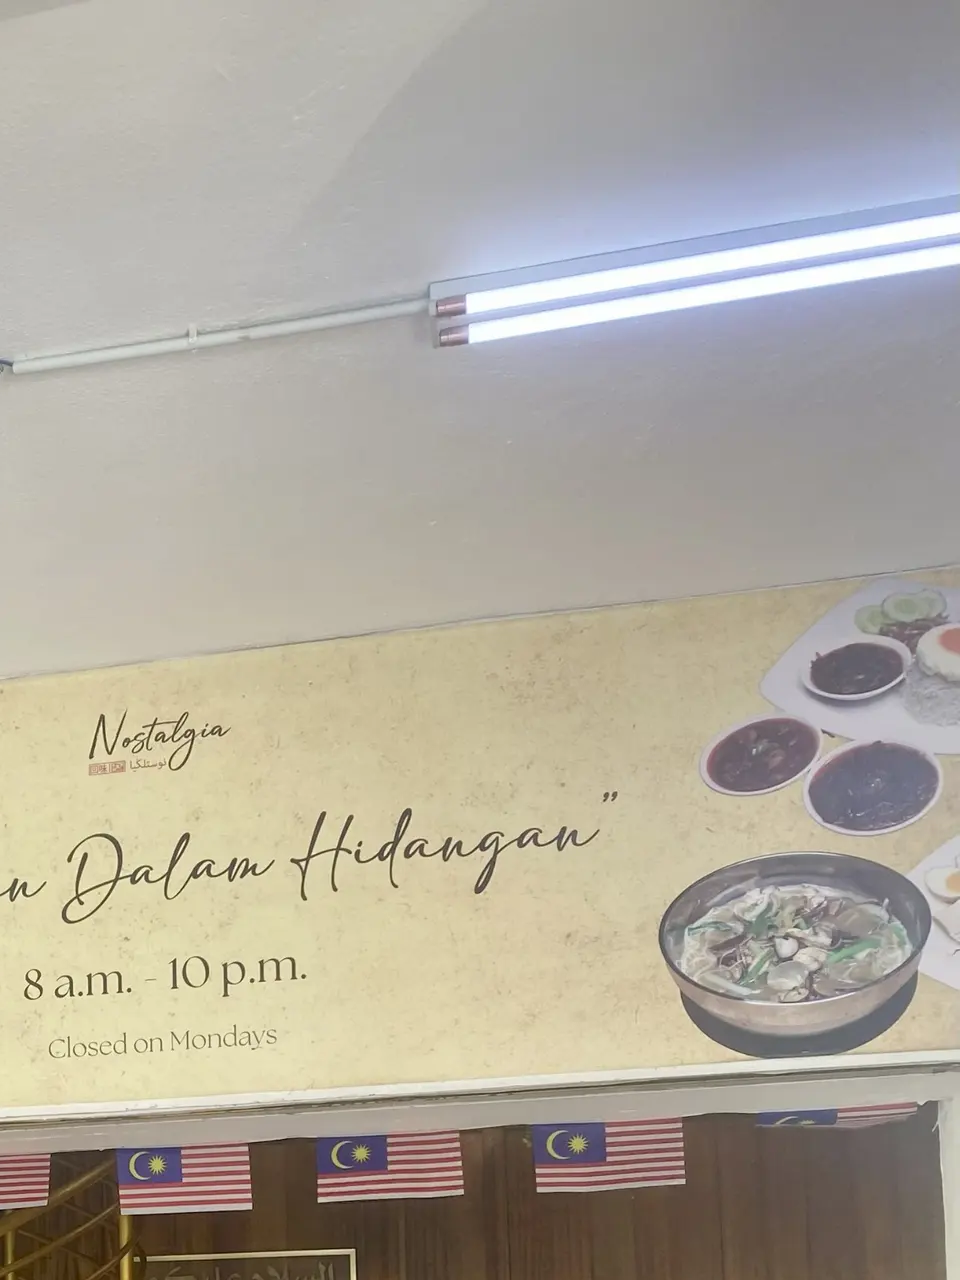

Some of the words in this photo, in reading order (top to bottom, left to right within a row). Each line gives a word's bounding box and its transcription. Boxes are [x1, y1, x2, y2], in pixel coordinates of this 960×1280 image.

[89, 708, 231, 771] Nostalgia
[62, 831, 275, 924] Dalam
[23, 968, 44, 1001] 8
[54, 970, 133, 999] a.m.
[169, 956, 210, 989] 10
[222, 956, 308, 998] p.m.
[48, 1032, 128, 1059] Closed
[133, 1037, 164, 1053] on
[170, 1023, 278, 1052] Mondays
